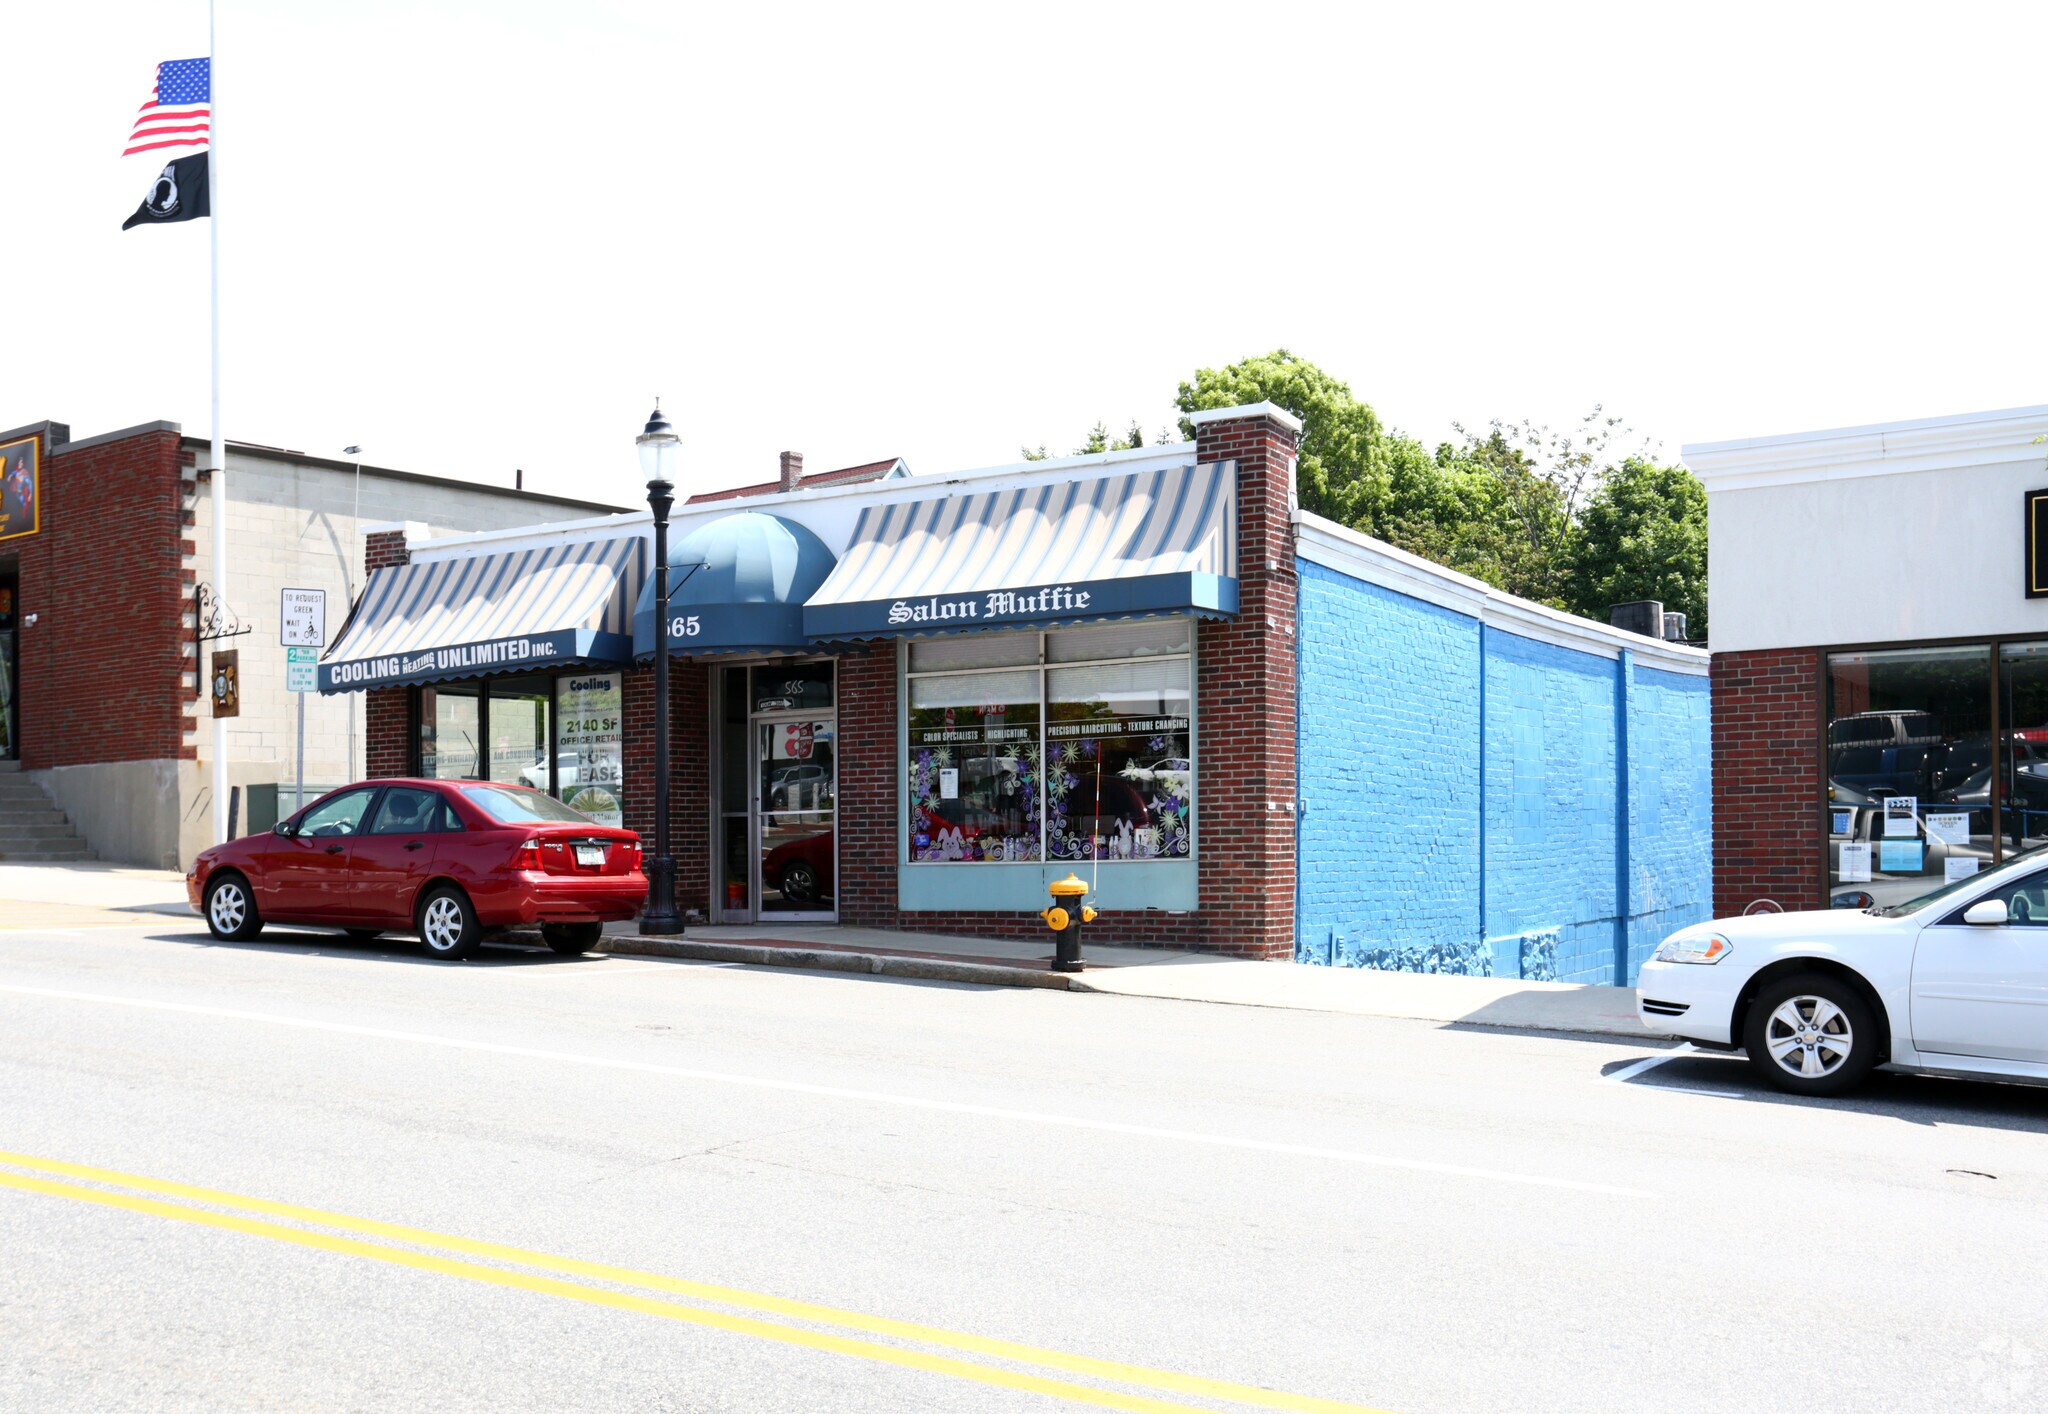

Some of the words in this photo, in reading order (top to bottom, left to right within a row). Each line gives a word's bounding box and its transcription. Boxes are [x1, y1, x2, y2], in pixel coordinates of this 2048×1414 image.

[295, 594, 322, 602] REQUEST
[887, 596, 978, 625] Salon
[983, 585, 1092, 619] Muffie
[286, 619, 300, 627] WAIT
[288, 649, 297, 660] 2
[437, 639, 530, 669] UNLIMITED
[532, 641, 557, 657] INC.
[402, 656, 409, 664] &
[402, 651, 435, 674] HEATING
[330, 655, 400, 684] COOLING
[570, 677, 611, 692] Cooling
[784, 680, 804, 695] 565
[566, 718, 598, 733] 2140
[602, 717, 618, 731] SF
[1047, 725, 1080, 736] PRECISION
[1081, 722, 1122, 735] HAIRCUTTING
[1127, 720, 1154, 732] TEXTURE
[1154, 718, 1188, 731] CHANGING
[560, 735, 593, 746] OFFICE/
[595, 733, 622, 743] RETAIL
[923, 732, 941, 742] COLOR
[942, 730, 979, 741] SPECIALISTS
[987, 728, 1028, 739] HIGHLIGHTING
